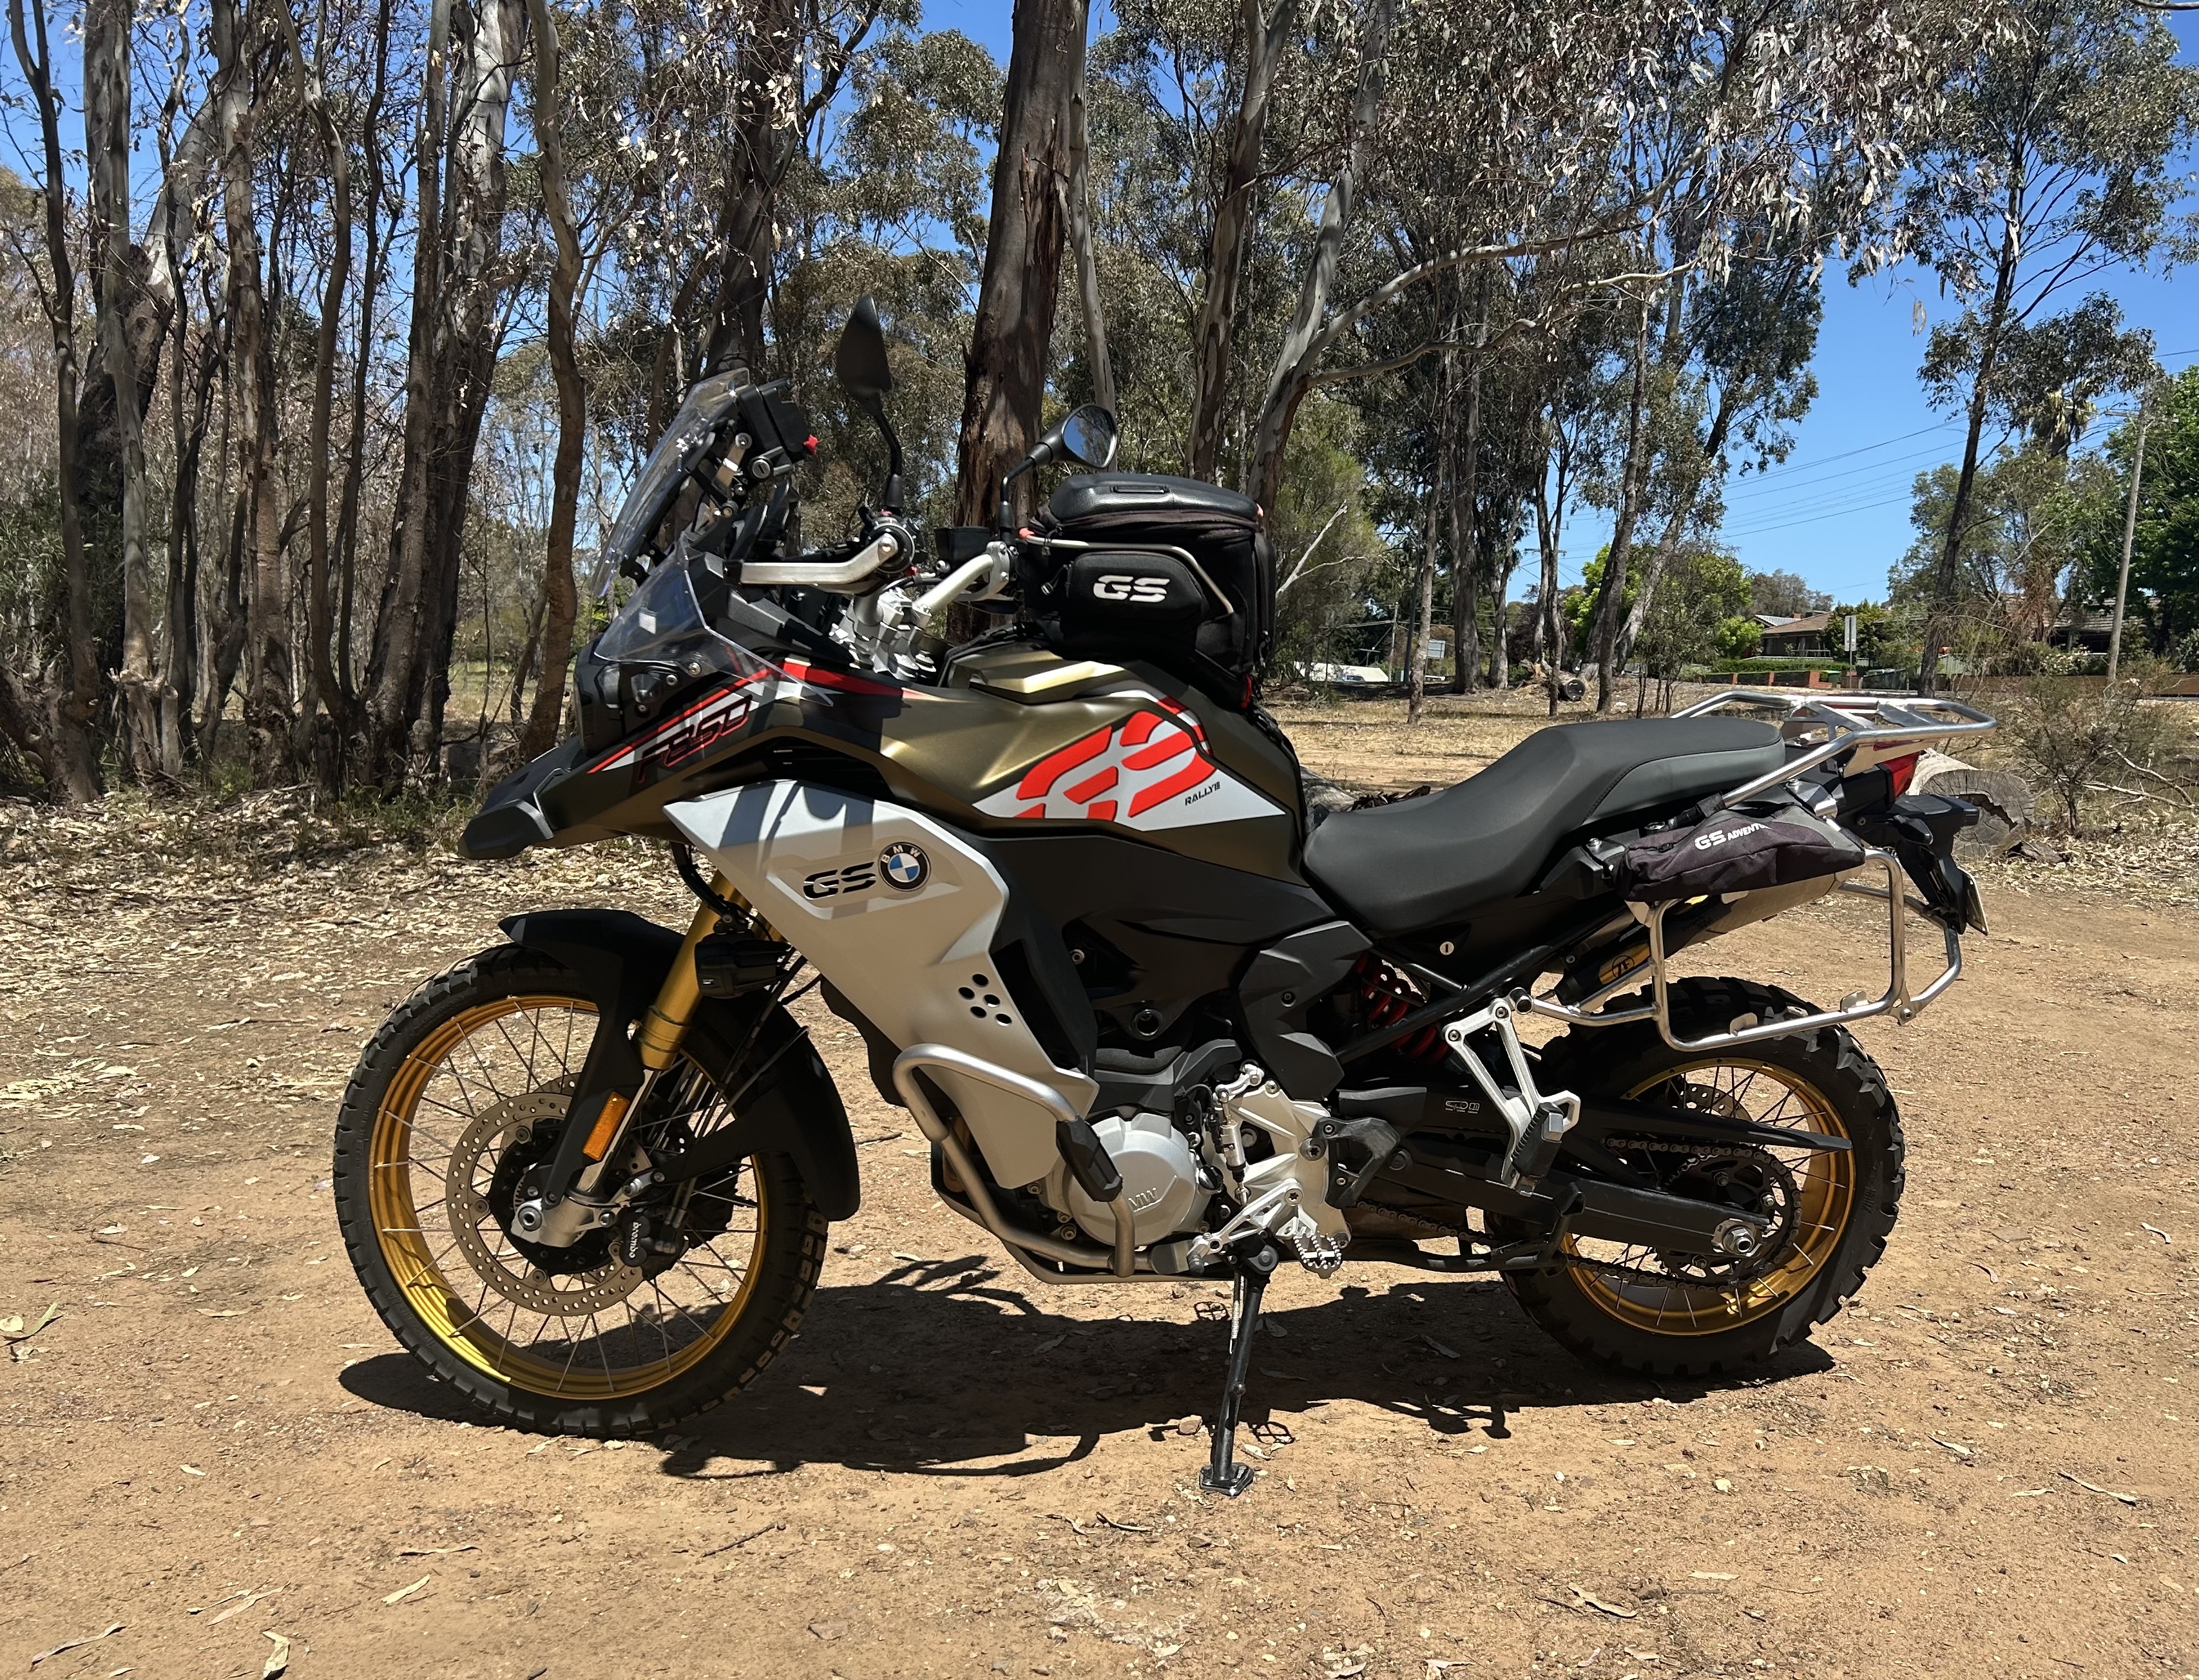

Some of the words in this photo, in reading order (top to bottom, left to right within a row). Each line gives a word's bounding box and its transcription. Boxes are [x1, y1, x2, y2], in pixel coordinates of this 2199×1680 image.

[1093, 575, 1170, 603] GS
[1695, 830, 1727, 850] GS
[880, 845, 923, 864] BMW
[803, 861, 877, 901] GS
[1128, 1187, 1158, 1208] MW
[629, 1221, 642, 1258] brembo
